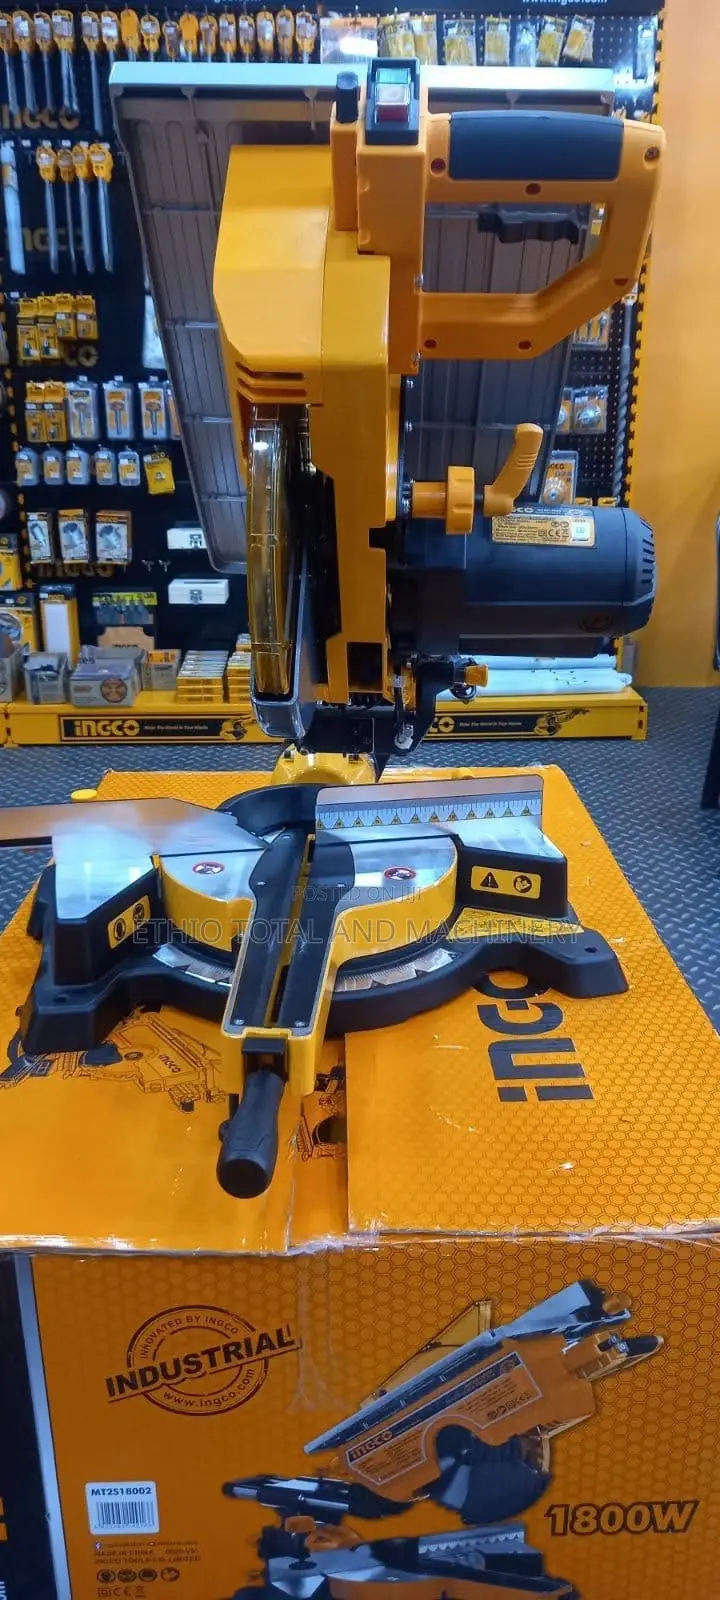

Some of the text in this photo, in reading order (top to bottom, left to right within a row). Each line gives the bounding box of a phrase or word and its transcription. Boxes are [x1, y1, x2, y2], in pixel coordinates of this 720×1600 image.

[74, 719, 140, 737] INGCO
[140, 1315, 239, 1359] INNOVATED BY INGCO
[105, 1327, 296, 1398] INDUSTRIAL
[163, 1368, 256, 1408] www.ingco.com
[544, 1500, 699, 1536] 1800W
